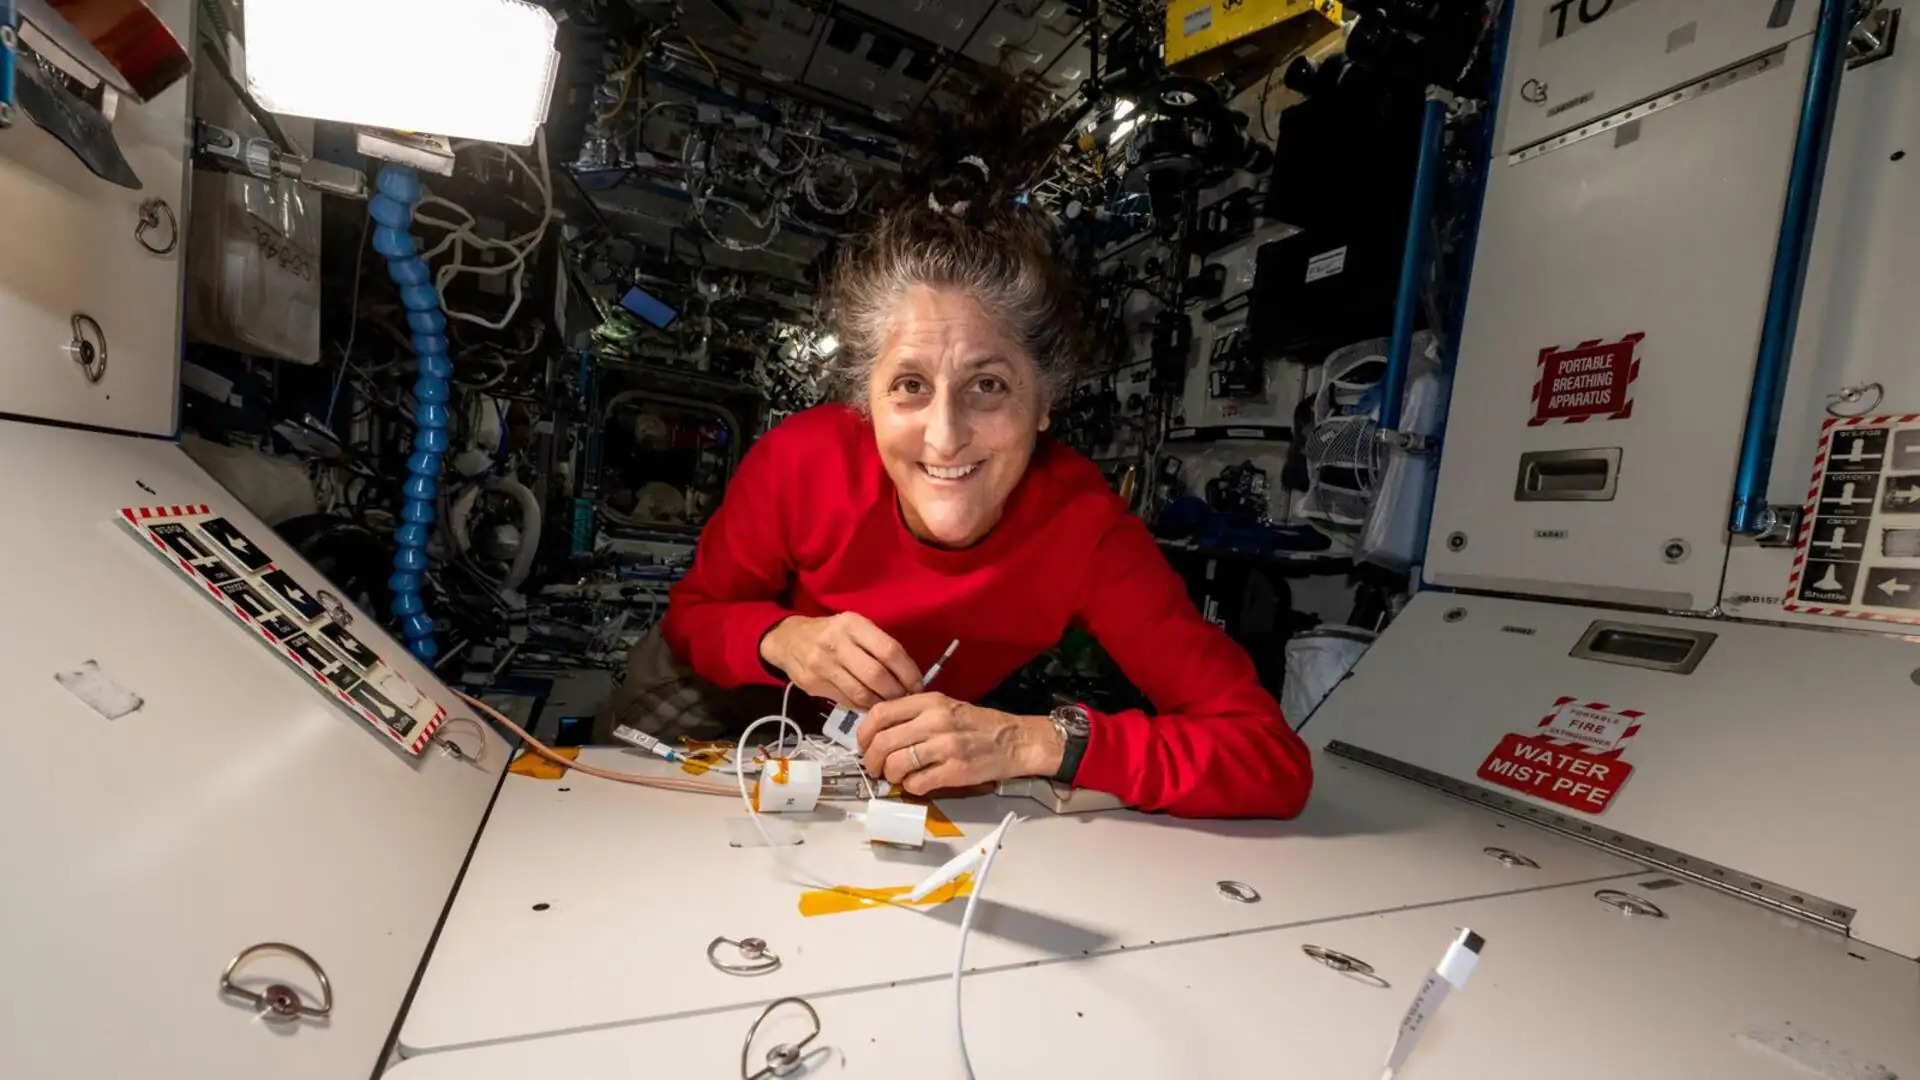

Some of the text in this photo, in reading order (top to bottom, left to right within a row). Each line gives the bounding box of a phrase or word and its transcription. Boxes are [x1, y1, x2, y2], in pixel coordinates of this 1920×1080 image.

[1558, 353, 1615, 374] PORTABLE
[1552, 371, 1613, 393] BREATHING
[1548, 389, 1612, 409] APPARATUS
[1804, 590, 1847, 600] Shuttle
[1569, 707, 1621, 725] PORTABLE
[1568, 718, 1606, 735] FIRE
[1514, 743, 1610, 781] WATER
[1488, 757, 1611, 805] MIST PFE
